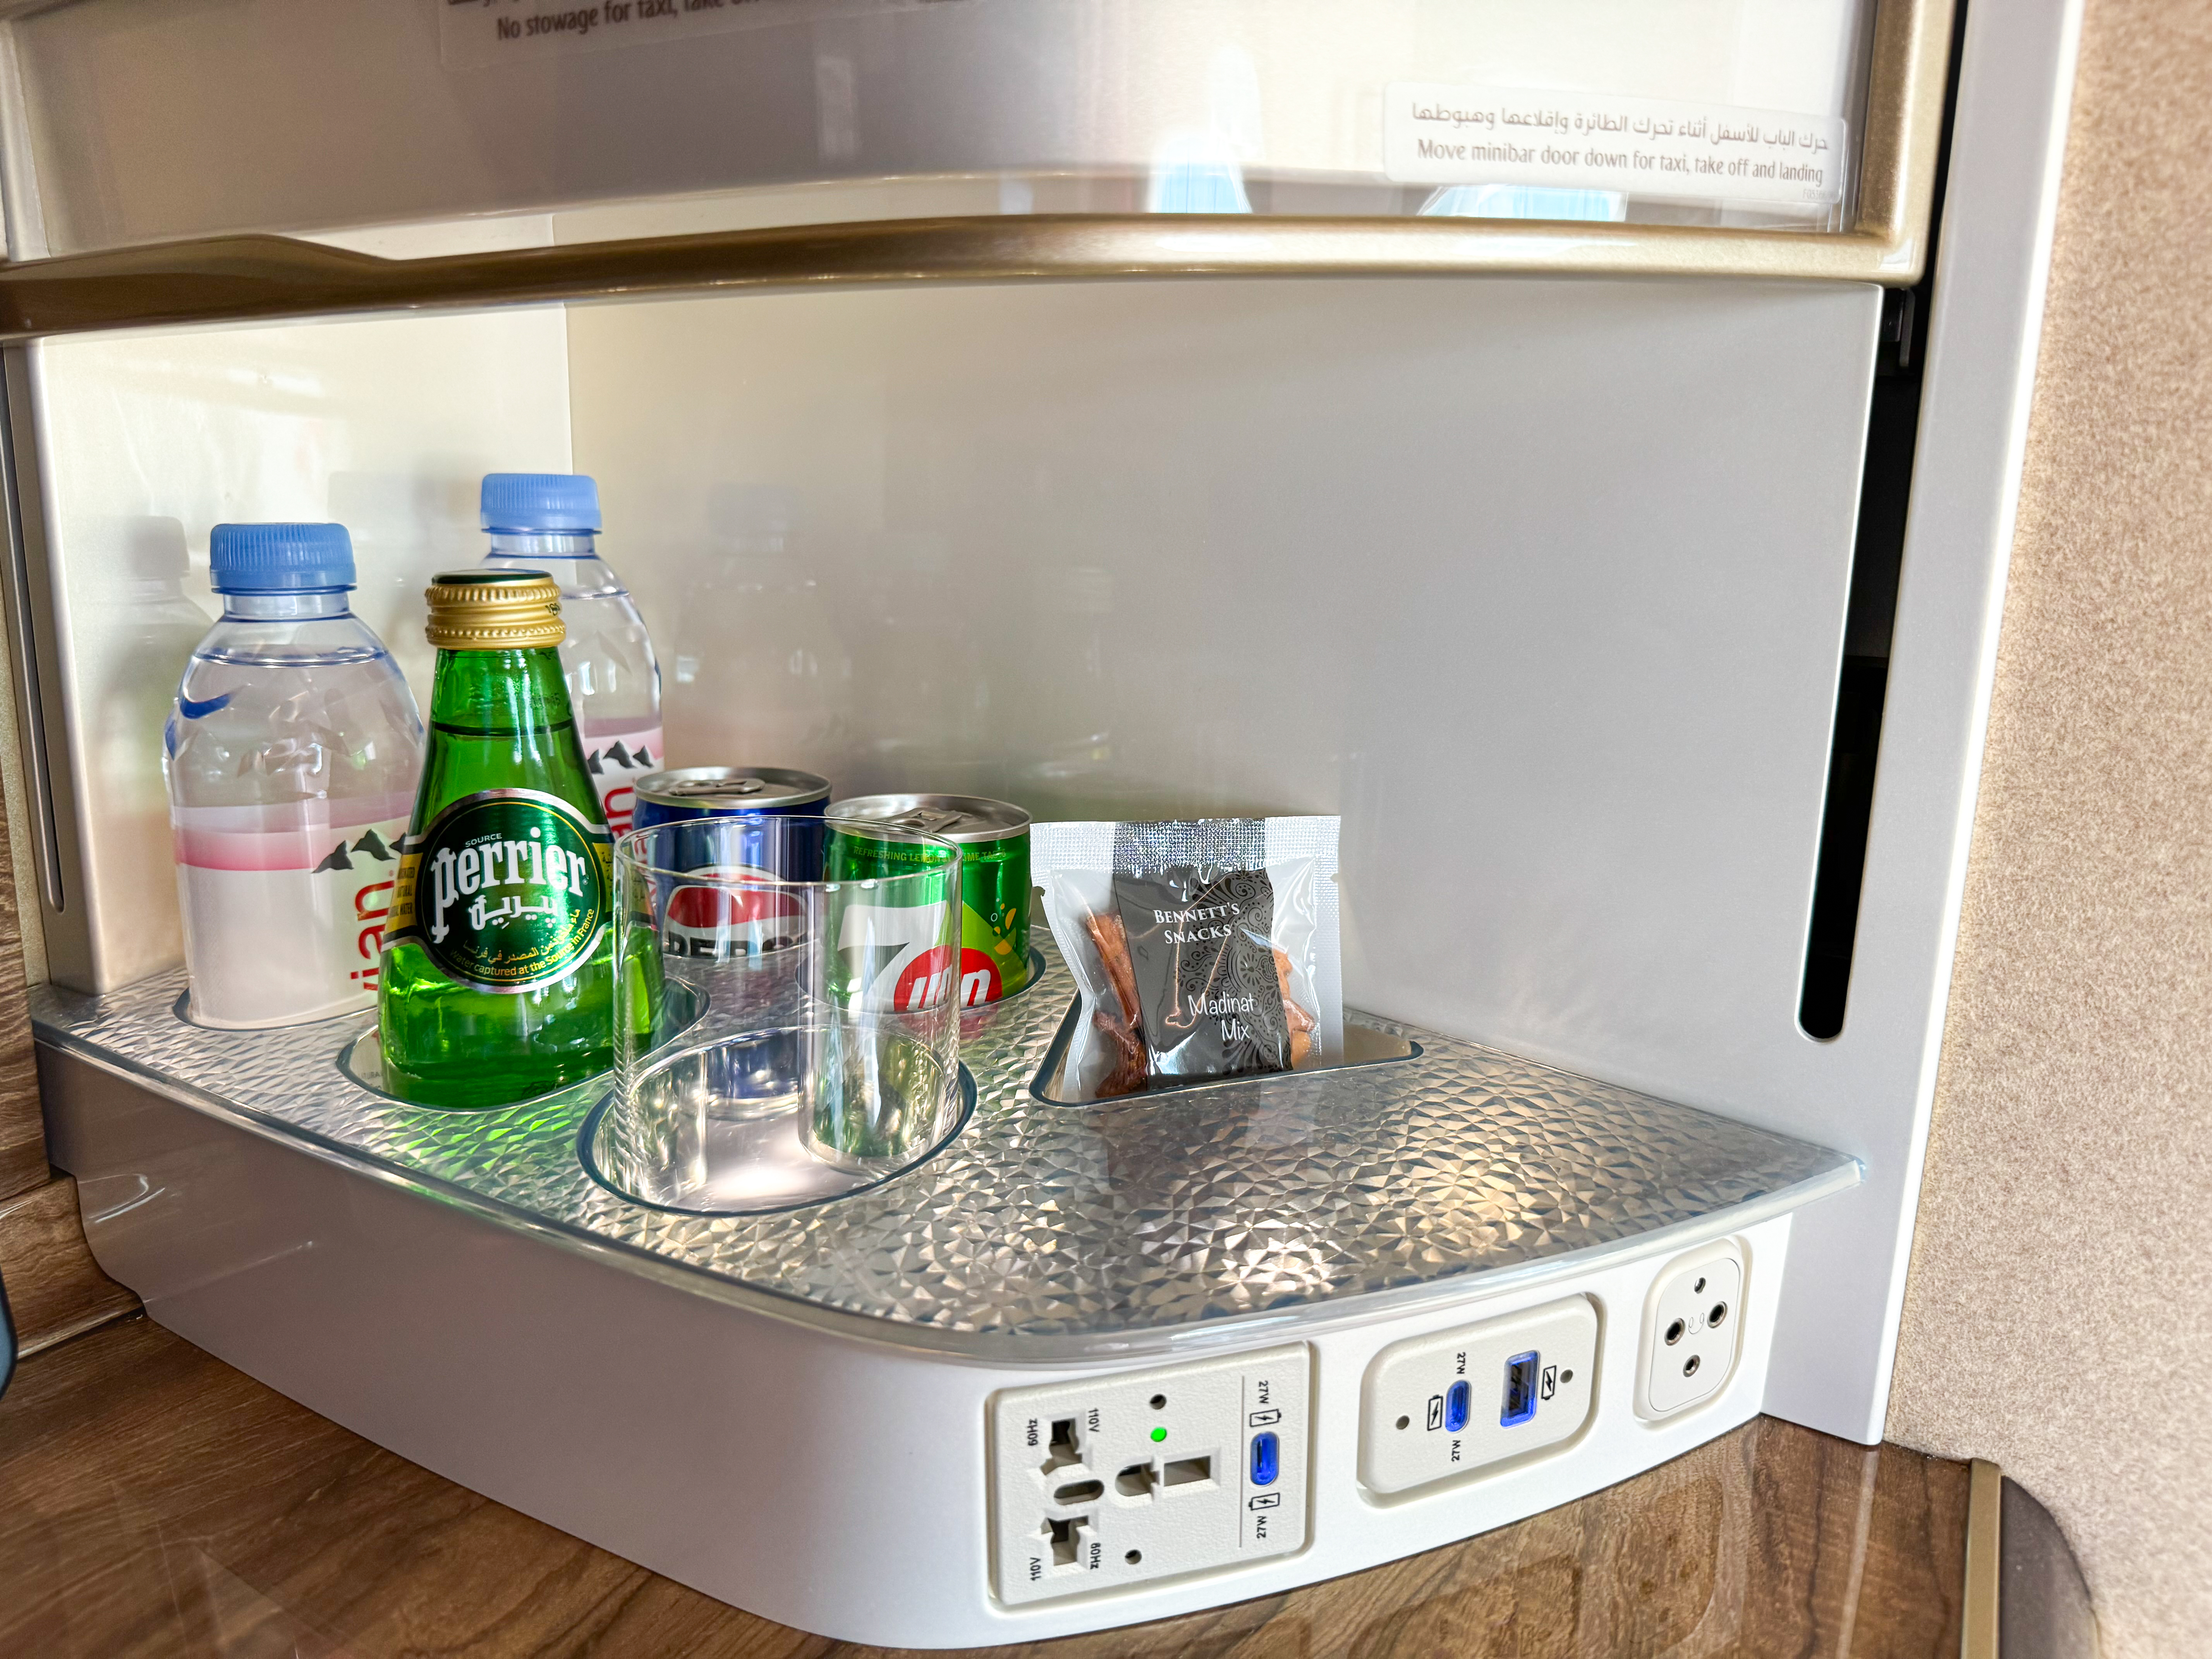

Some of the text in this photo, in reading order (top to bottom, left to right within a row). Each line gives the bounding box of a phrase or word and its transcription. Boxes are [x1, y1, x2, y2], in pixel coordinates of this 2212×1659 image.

[497, 17, 521, 40] No
[526, 6, 599, 35] stowage
[605, 0, 630, 23] for
[1412, 102, 1495, 130] وهبوطها
[1574, 112, 1628, 136] الطائرة
[1679, 116, 1707, 138] أثناء
[1633, 117, 1674, 141] تحرك
[1711, 122, 1759, 145] للأسفل
[1763, 130, 1795, 151] الباب
[1799, 132, 1828, 154] حرك
[1417, 139, 1823, 187] Move minibar door down for taxi, take off and landing
[465, 833, 502, 847] SOURCE
[854, 846, 907, 861] REFRESHING
[1153, 902, 1240, 925] BENNETT'S
[450, 908, 594, 976] Water captured at the Source in France
[1164, 924, 1232, 944] SNACKS
[488, 950, 503, 964] في
[1188, 991, 1254, 1017] Madinat
[1221, 1018, 1250, 1042] Mix
[1456, 1351, 1466, 1375] 27W
[1257, 1380, 1269, 1404] 27W
[1027, 1418, 1038, 1446] 60Hz
[1088, 1408, 1100, 1432] 110V
[1451, 1439, 1461, 1462] 27W
[1256, 1515, 1267, 1539] 27W
[1090, 1542, 1101, 1570] 60Hz
[1030, 1557, 1041, 1581] 110V
